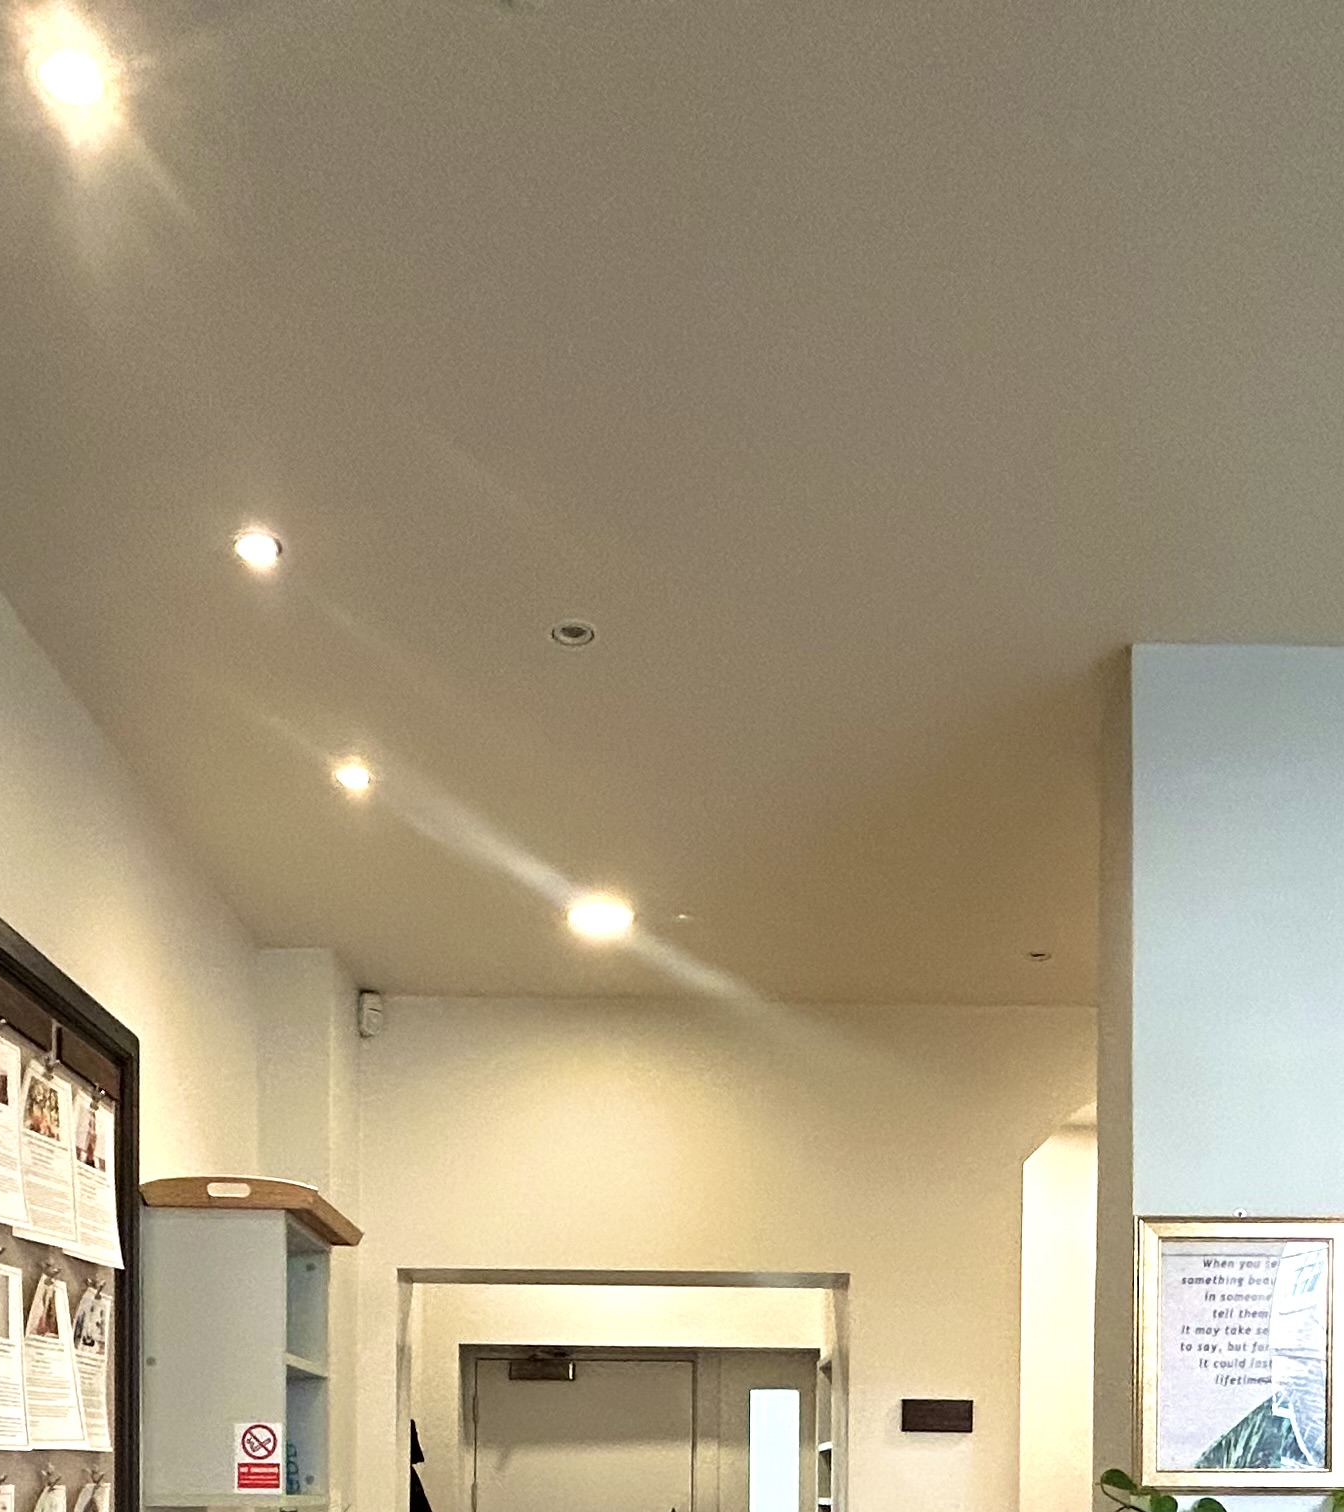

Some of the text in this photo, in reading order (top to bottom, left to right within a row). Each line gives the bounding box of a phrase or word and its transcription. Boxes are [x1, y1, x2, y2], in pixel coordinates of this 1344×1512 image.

[1203, 1258, 1235, 1269] When
[1238, 1260, 1261, 1271] you
[1181, 1274, 1245, 1287] something
[1212, 1308, 1234, 1320] tell
[1194, 1326, 1221, 1337] may
[1224, 1325, 1252, 1336] take
[1180, 1342, 1193, 1352] to
[1227, 1341, 1248, 1352] but
[1251, 1341, 1270, 1354] for
[1213, 1358, 1247, 1369] could
